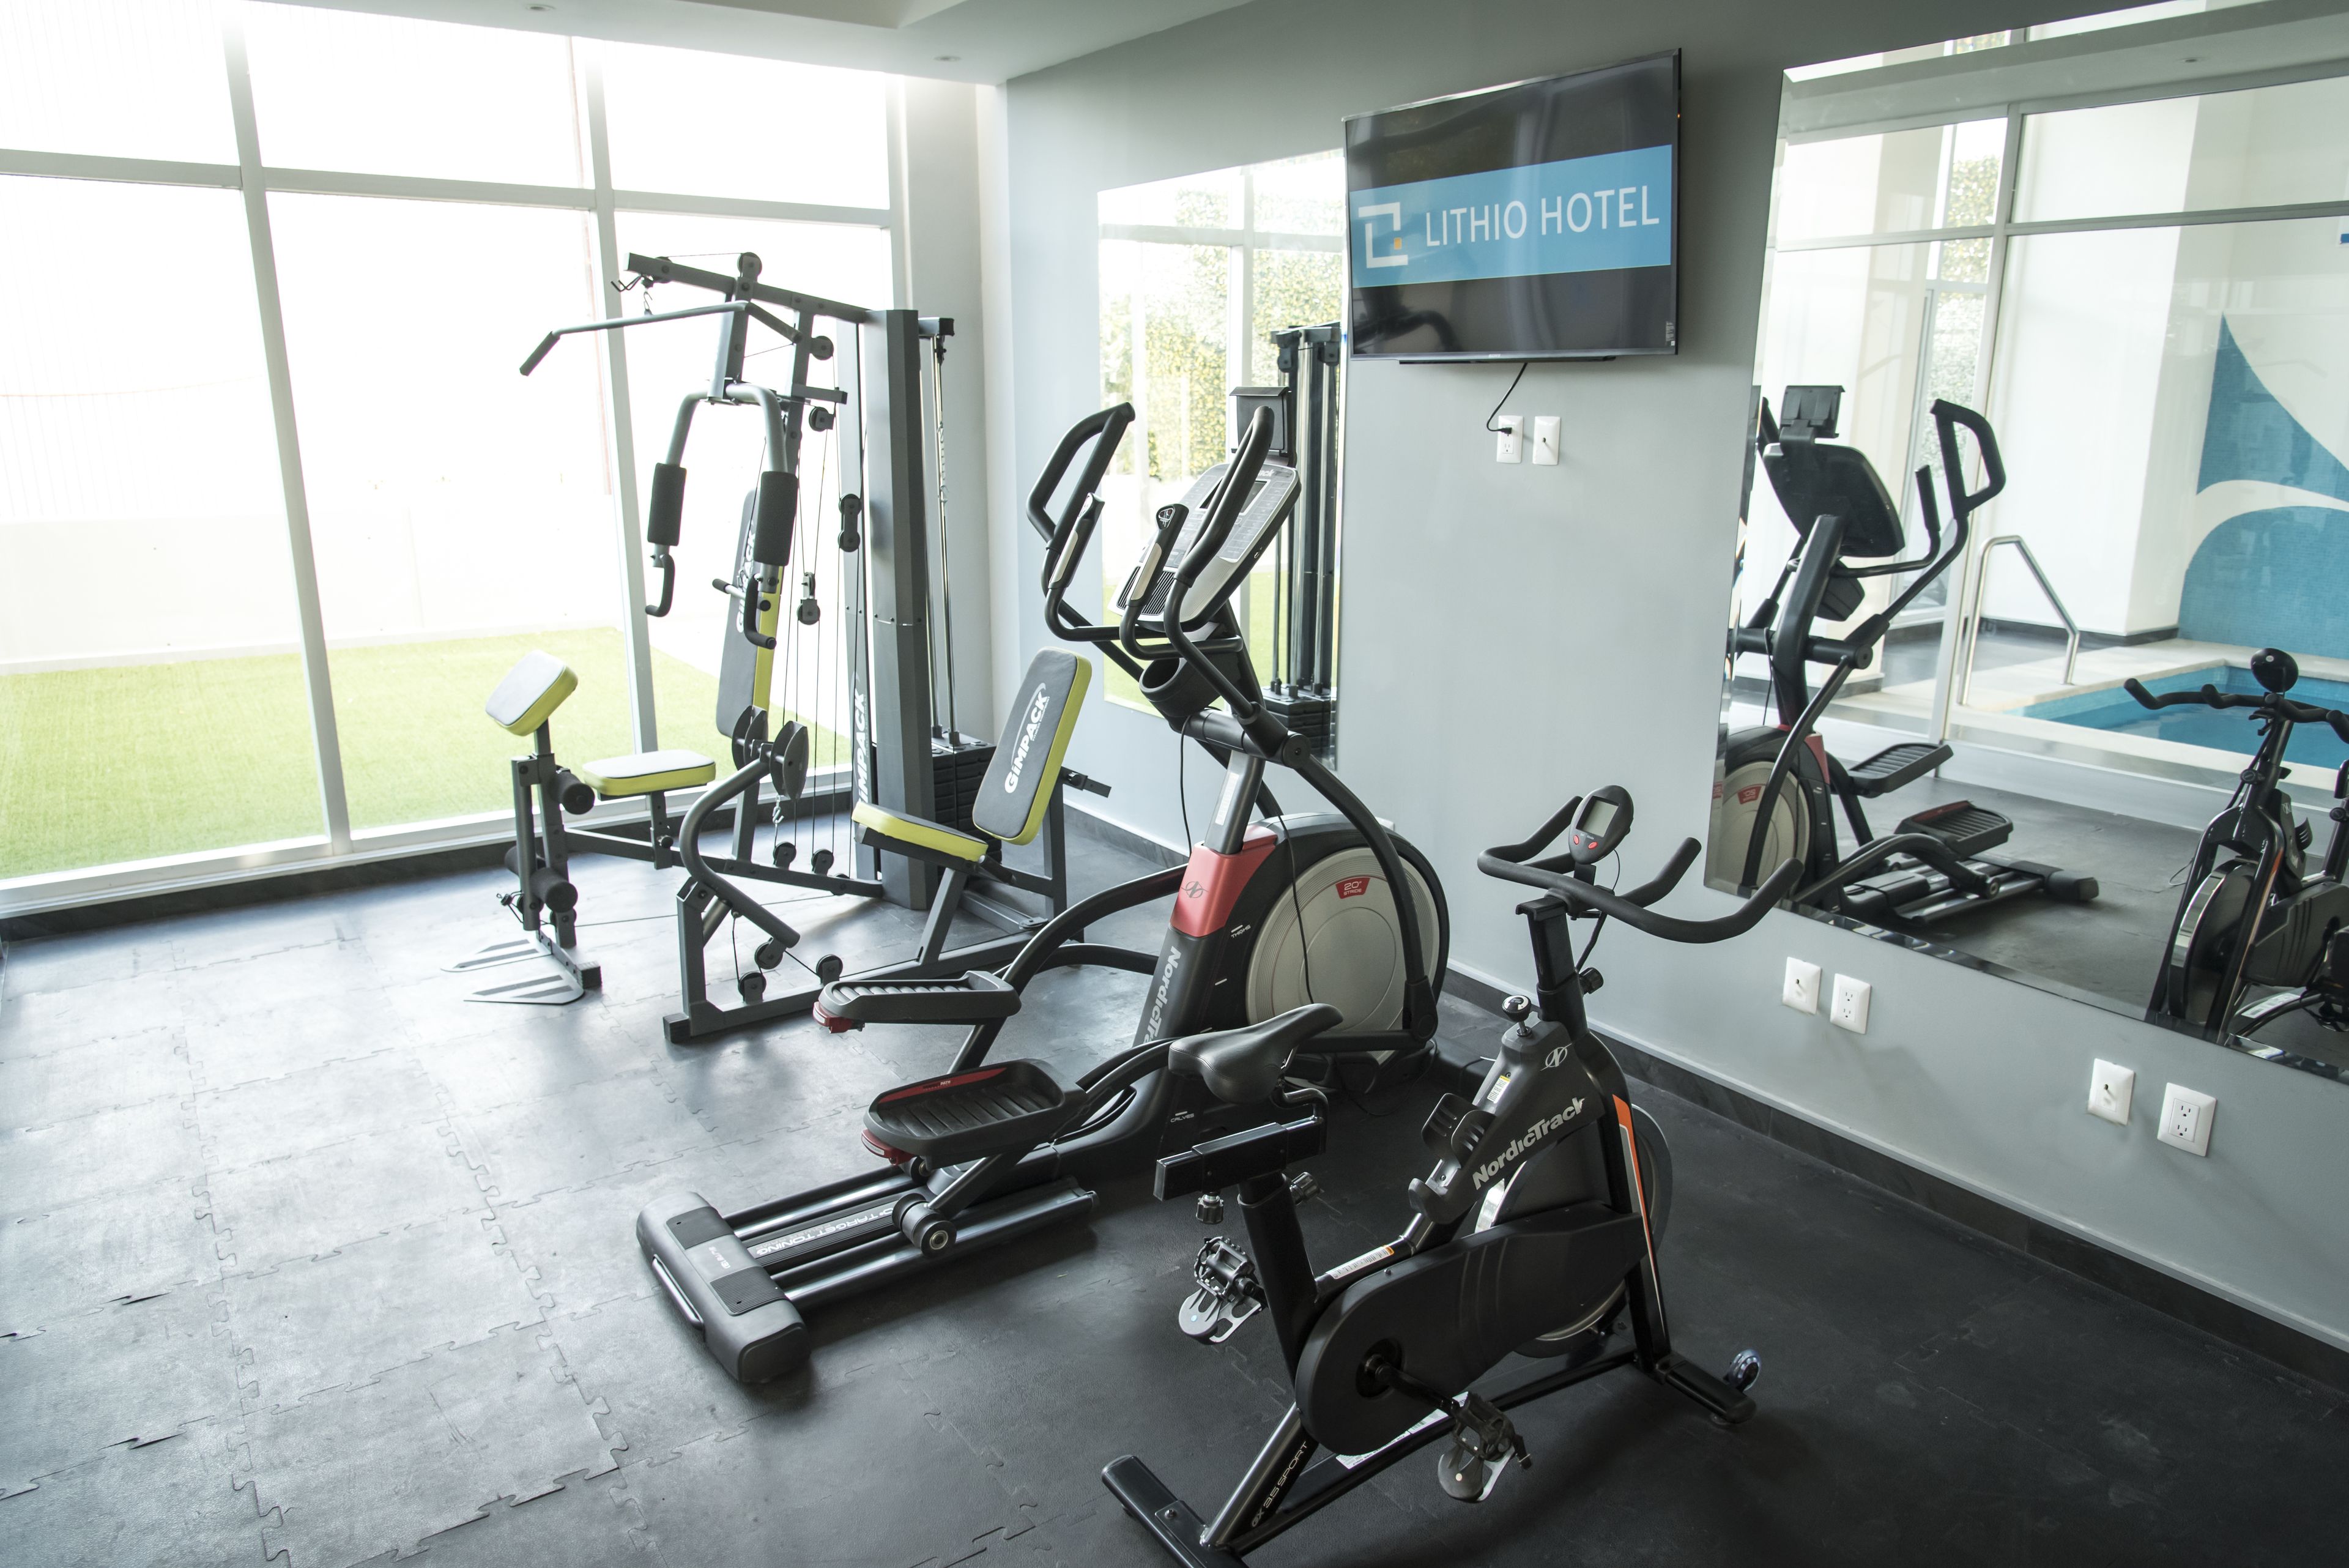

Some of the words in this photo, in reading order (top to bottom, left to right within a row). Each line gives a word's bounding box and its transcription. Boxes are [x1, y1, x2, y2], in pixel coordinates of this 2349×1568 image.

[1426, 200, 1527, 247] LITHIO
[1542, 185, 1660, 236] HOTEL
[1231, 924, 1251, 938] THIGHS
[1170, 1113, 1195, 1123] CALVES
[1472, 1098, 1585, 1190] NordicTrack
[817, 1215, 878, 1237] TARGET
[757, 1232, 815, 1255] TONING
[1252, 1508, 1264, 1527] GX
[1277, 1441, 1307, 1486] SPORT
